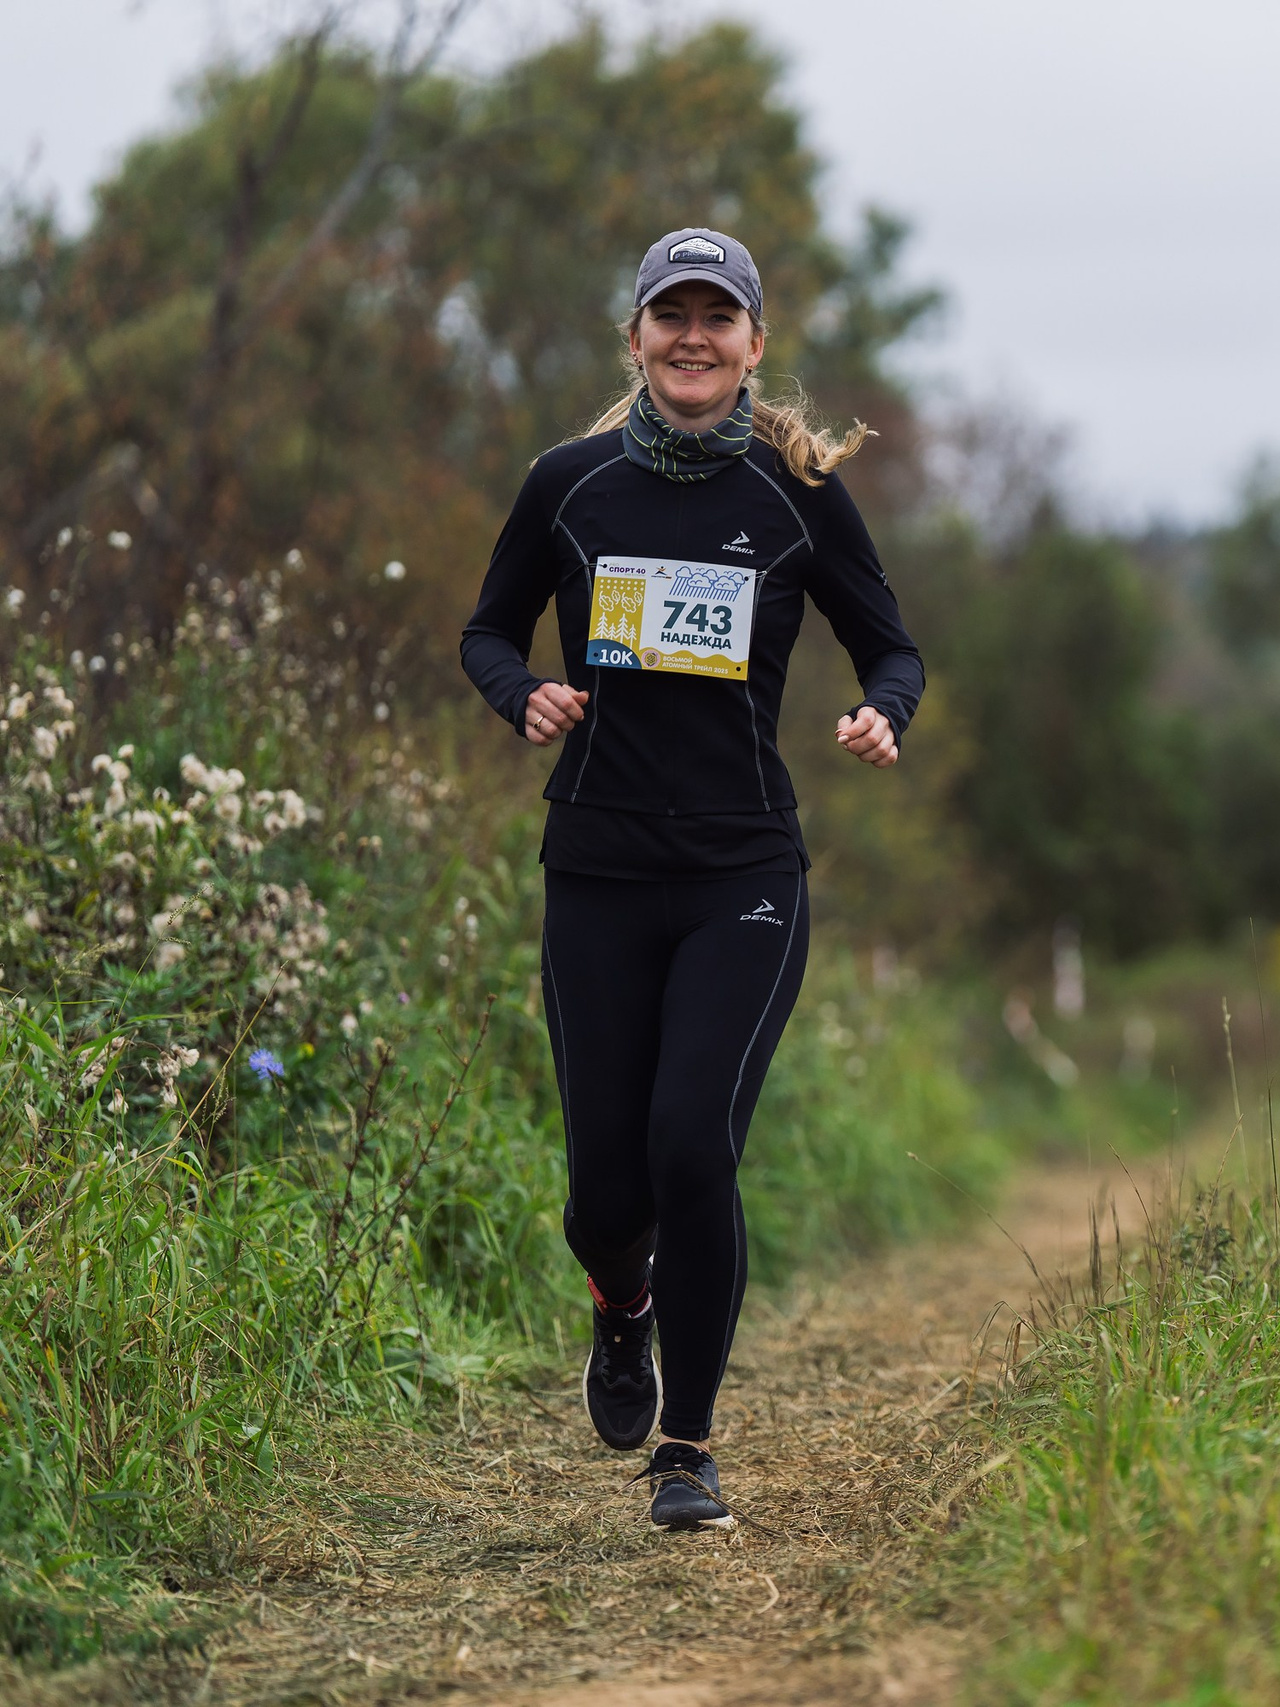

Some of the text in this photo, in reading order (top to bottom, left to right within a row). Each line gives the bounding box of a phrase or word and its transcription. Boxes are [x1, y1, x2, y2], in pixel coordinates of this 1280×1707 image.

[721, 544, 756, 555] DEMIX
[608, 566, 635, 574] СПОРТ
[663, 600, 732, 635] 743
[660, 631, 732, 650] НАДЕЖДА
[662, 656, 693, 664] ВОСЬМОЙ
[662, 661, 693, 670] АТОМНЫЙ
[694, 664, 713, 672] ТРЕЙЛ
[740, 914, 784, 926] DEMIX
